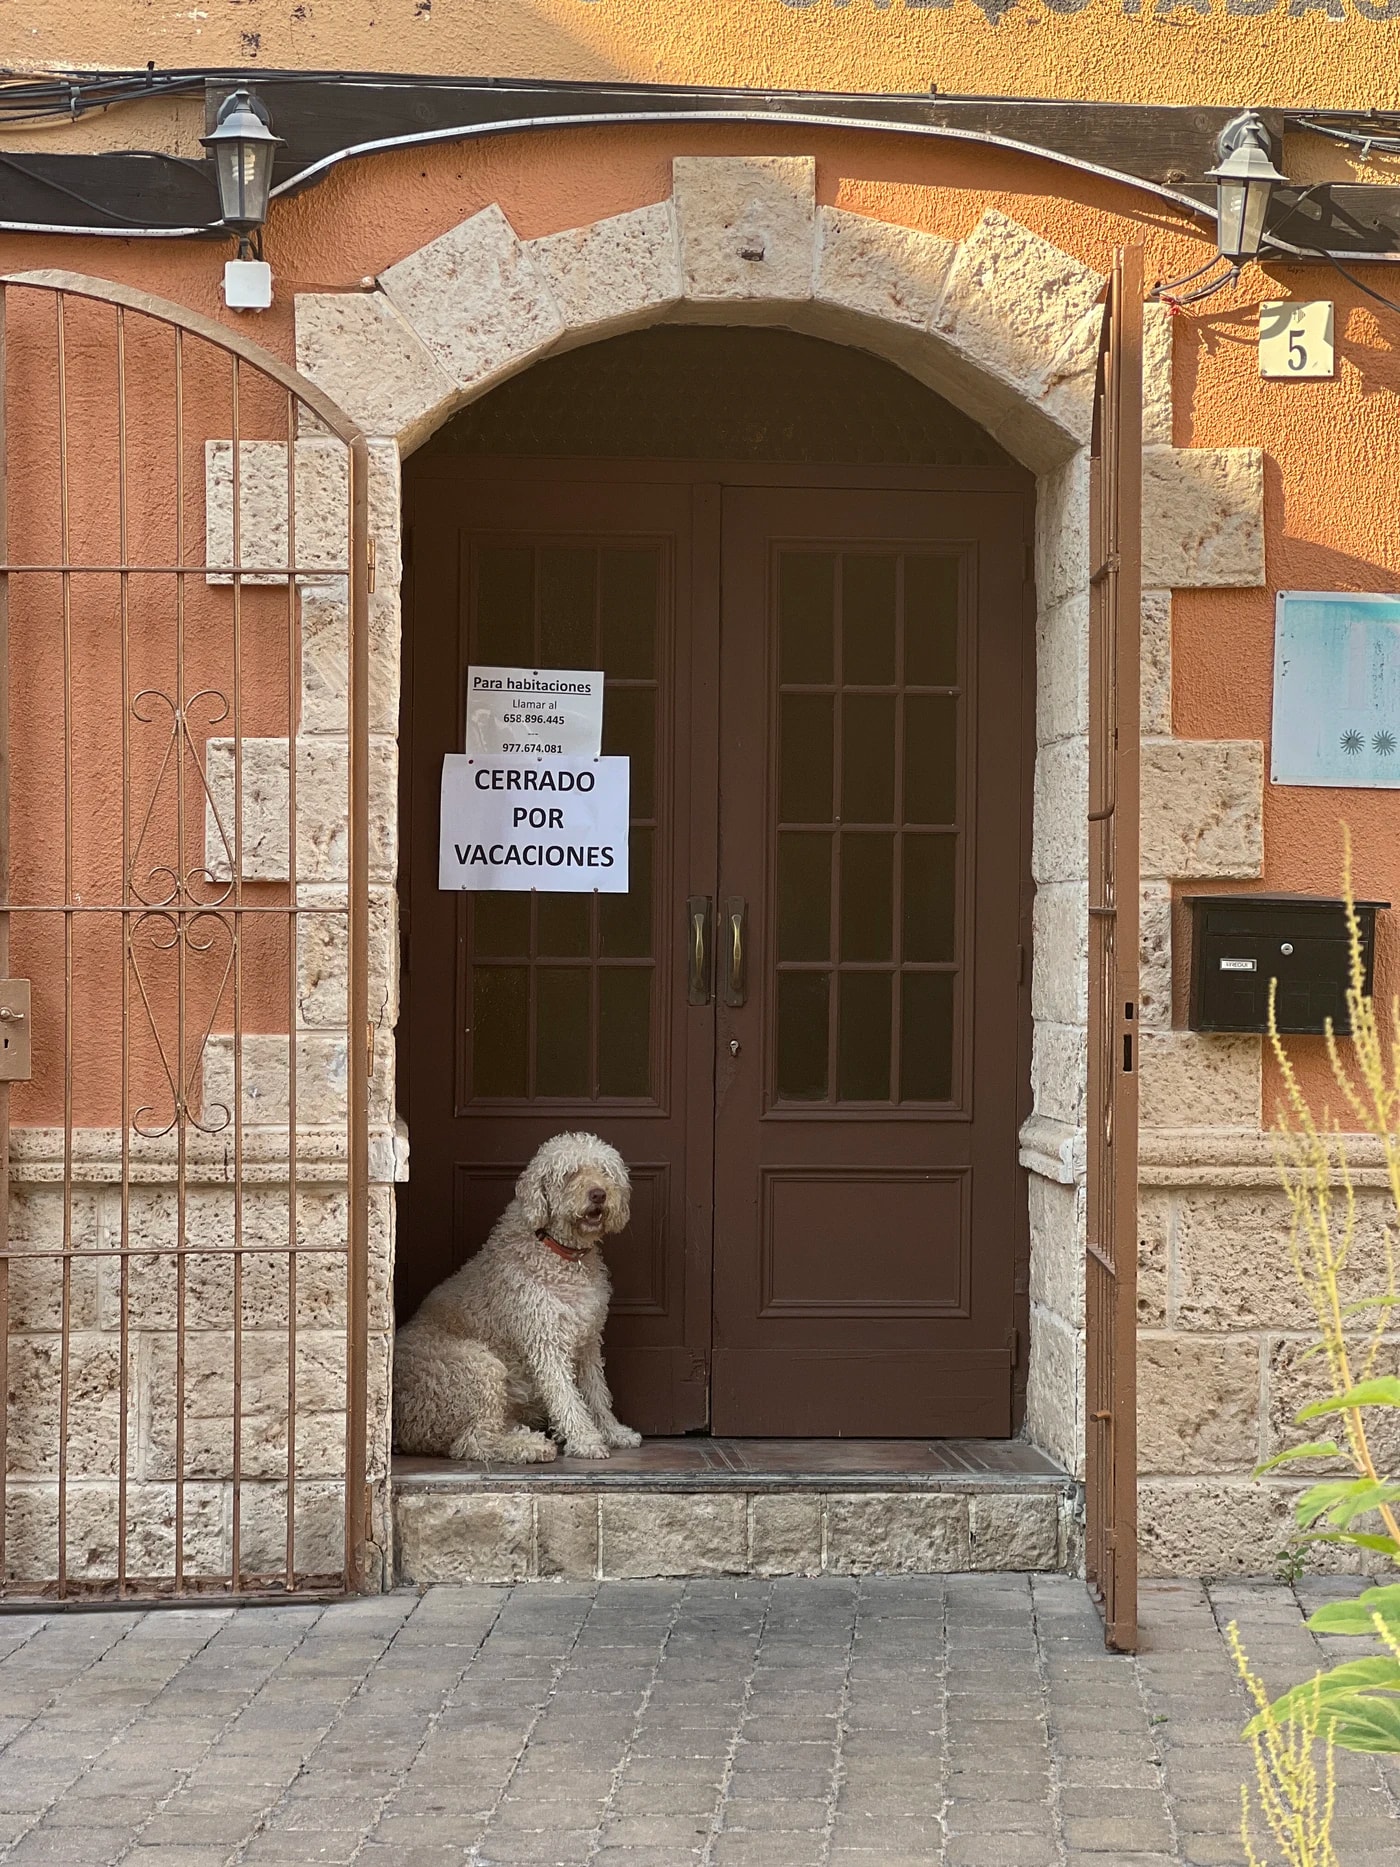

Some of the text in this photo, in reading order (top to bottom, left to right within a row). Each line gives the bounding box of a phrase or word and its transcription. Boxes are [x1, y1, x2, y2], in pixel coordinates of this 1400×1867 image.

[1288, 329, 1307, 371] 5
[473, 677, 591, 693] Para habitaciones
[512, 699, 557, 710] Llamar al
[503, 713, 565, 724] 658.896.445
[502, 743, 563, 754] 977.674.081
[475, 769, 595, 792] CERRADO
[513, 807, 564, 829] POR
[454, 844, 614, 867] VACACIONES
